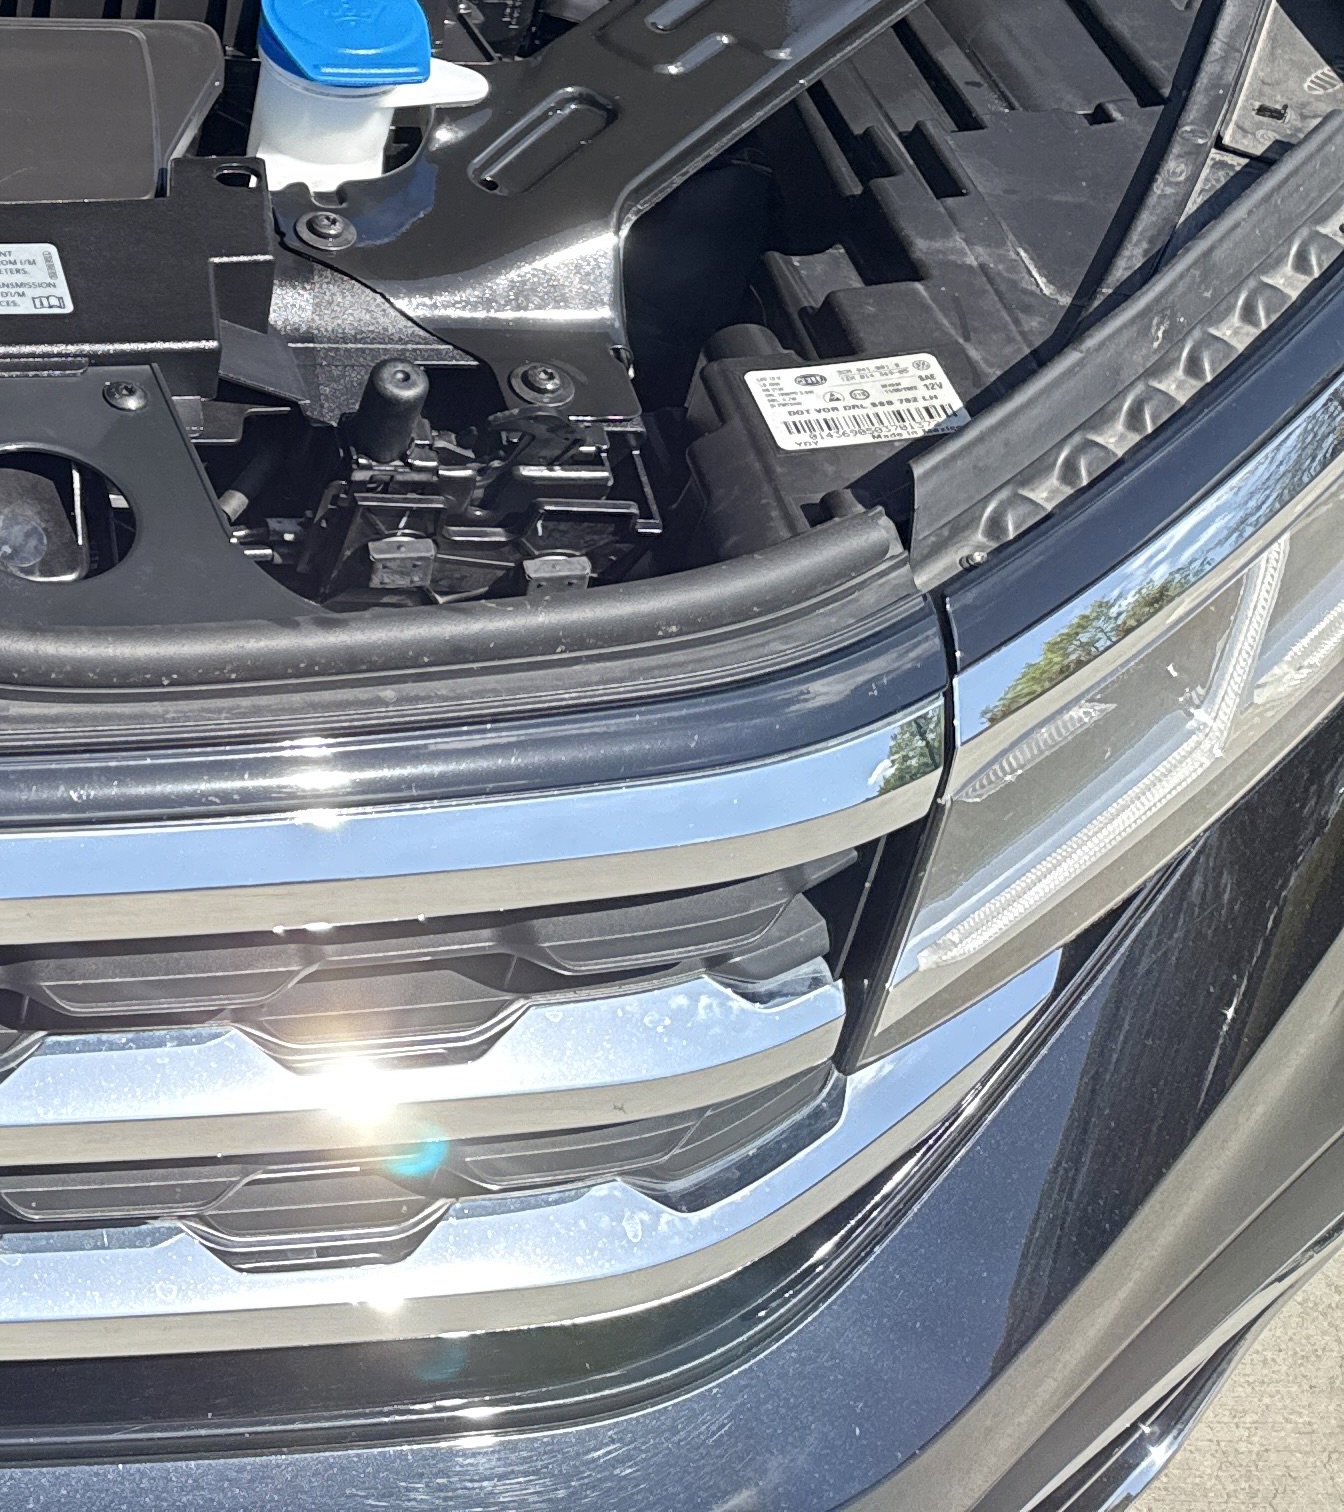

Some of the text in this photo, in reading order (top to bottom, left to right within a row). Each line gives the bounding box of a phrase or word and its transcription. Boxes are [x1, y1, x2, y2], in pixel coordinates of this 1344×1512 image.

[917, 373, 937, 382] SAE
[921, 381, 944, 392] 12V
[787, 409, 811, 417] DOT
[813, 406, 840, 414] VOR
[871, 432, 904, 441] Made
